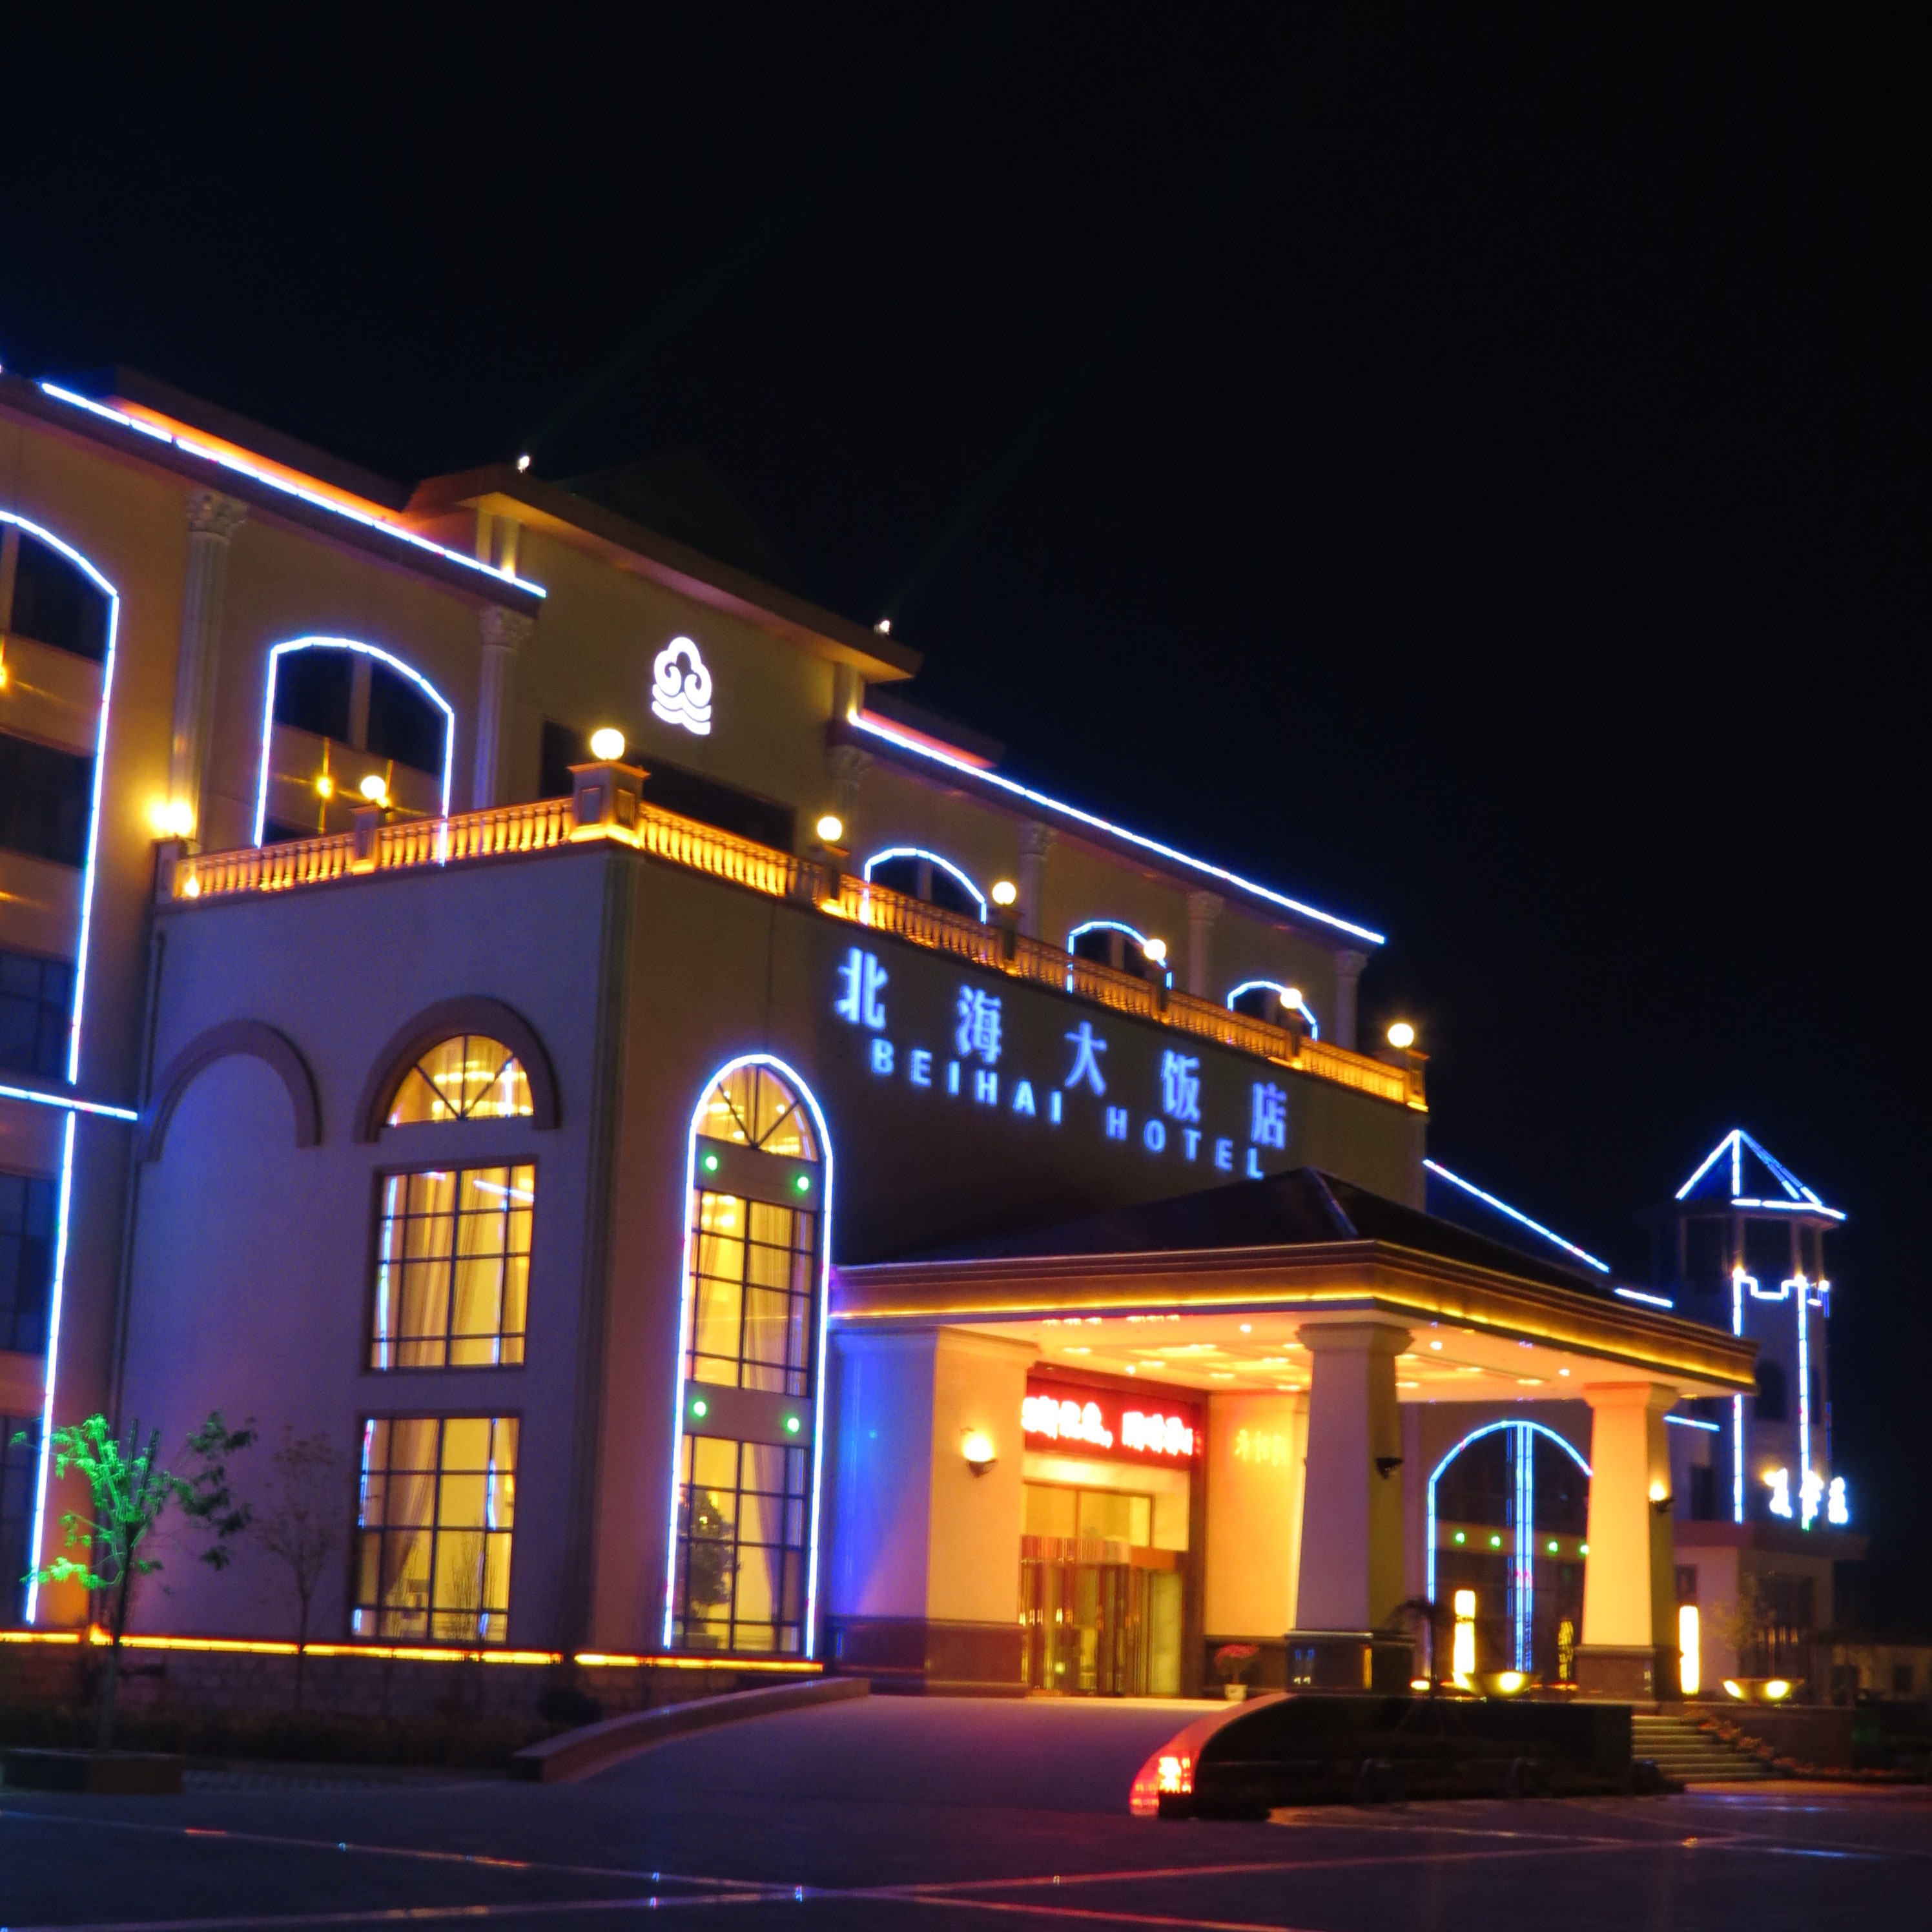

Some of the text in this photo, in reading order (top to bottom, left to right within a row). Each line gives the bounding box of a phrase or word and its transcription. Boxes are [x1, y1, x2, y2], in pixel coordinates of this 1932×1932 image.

[836, 947, 1286, 1149] 北海大饭店
[872, 1038, 1264, 1180] BEIHAI HOTEL
